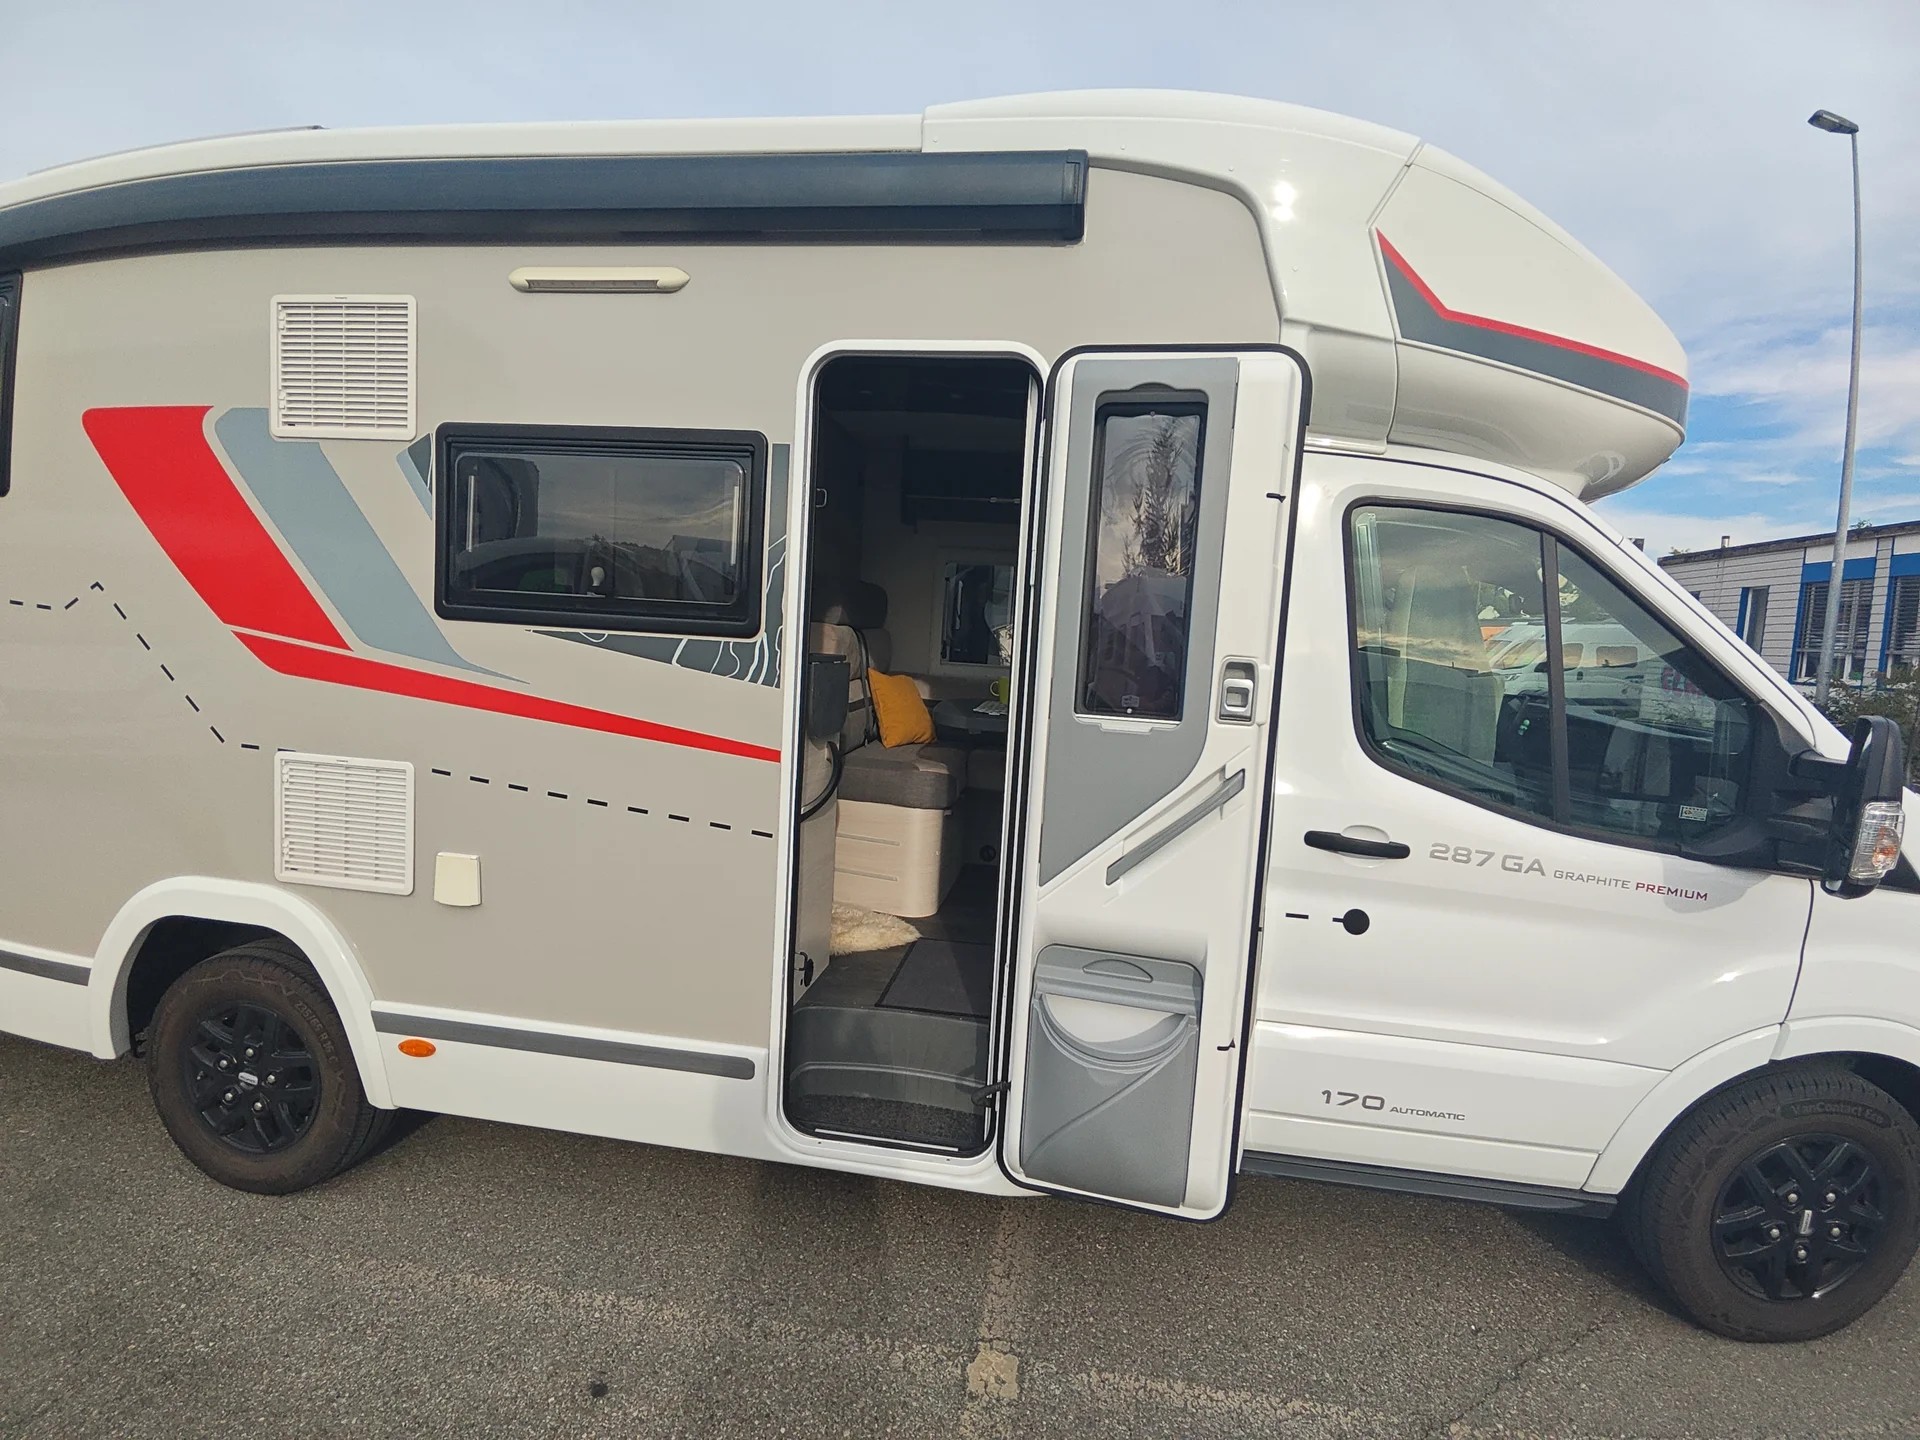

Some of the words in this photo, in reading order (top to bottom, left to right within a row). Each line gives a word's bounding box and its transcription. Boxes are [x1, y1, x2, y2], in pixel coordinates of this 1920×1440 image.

[1429, 842, 1496, 867] 287
[1501, 854, 1546, 877] GA
[1553, 869, 1632, 890] GRAPHITE
[1635, 882, 1709, 901] PREMIUM
[1321, 1089, 1386, 1111] 170
[1389, 1106, 1466, 1121] AUTOMATIC
